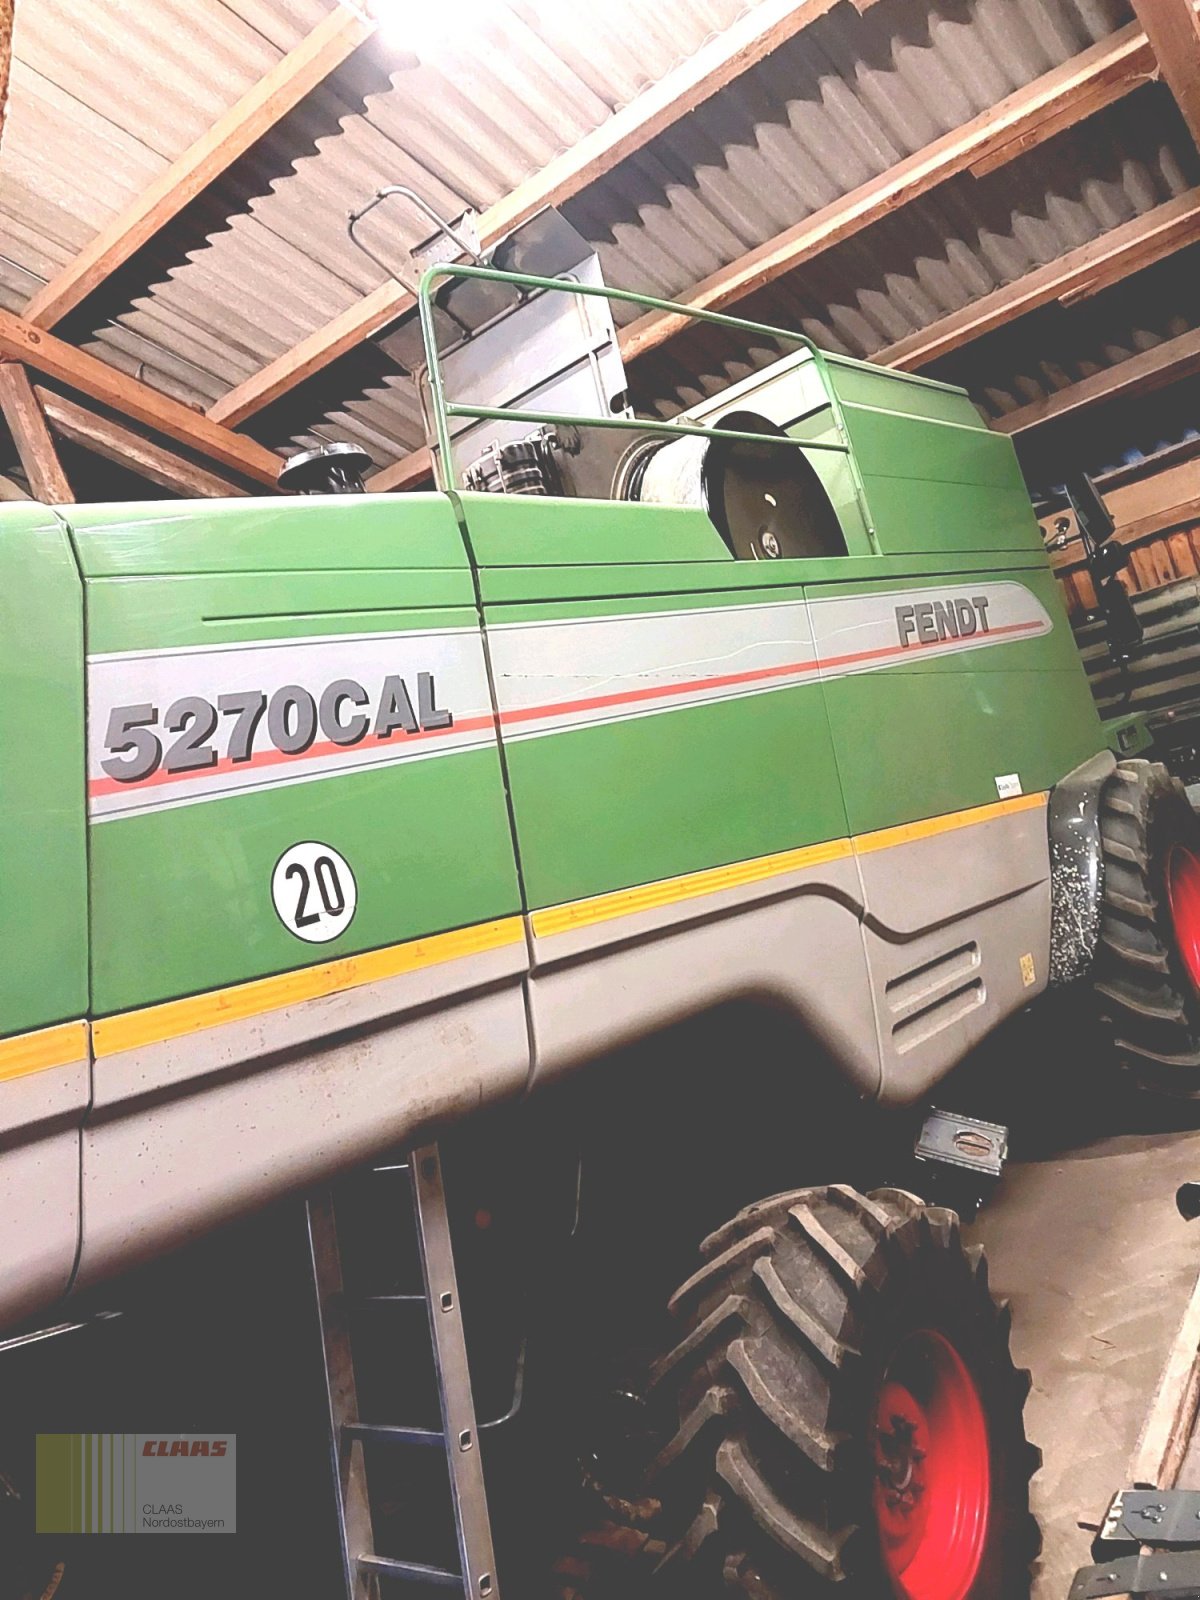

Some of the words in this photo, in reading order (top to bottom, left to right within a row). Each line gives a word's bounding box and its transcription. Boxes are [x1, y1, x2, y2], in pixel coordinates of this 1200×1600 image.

[895, 596, 989, 648] FENDT
[100, 672, 453, 783] 5270CAL
[285, 856, 345, 928] 20
